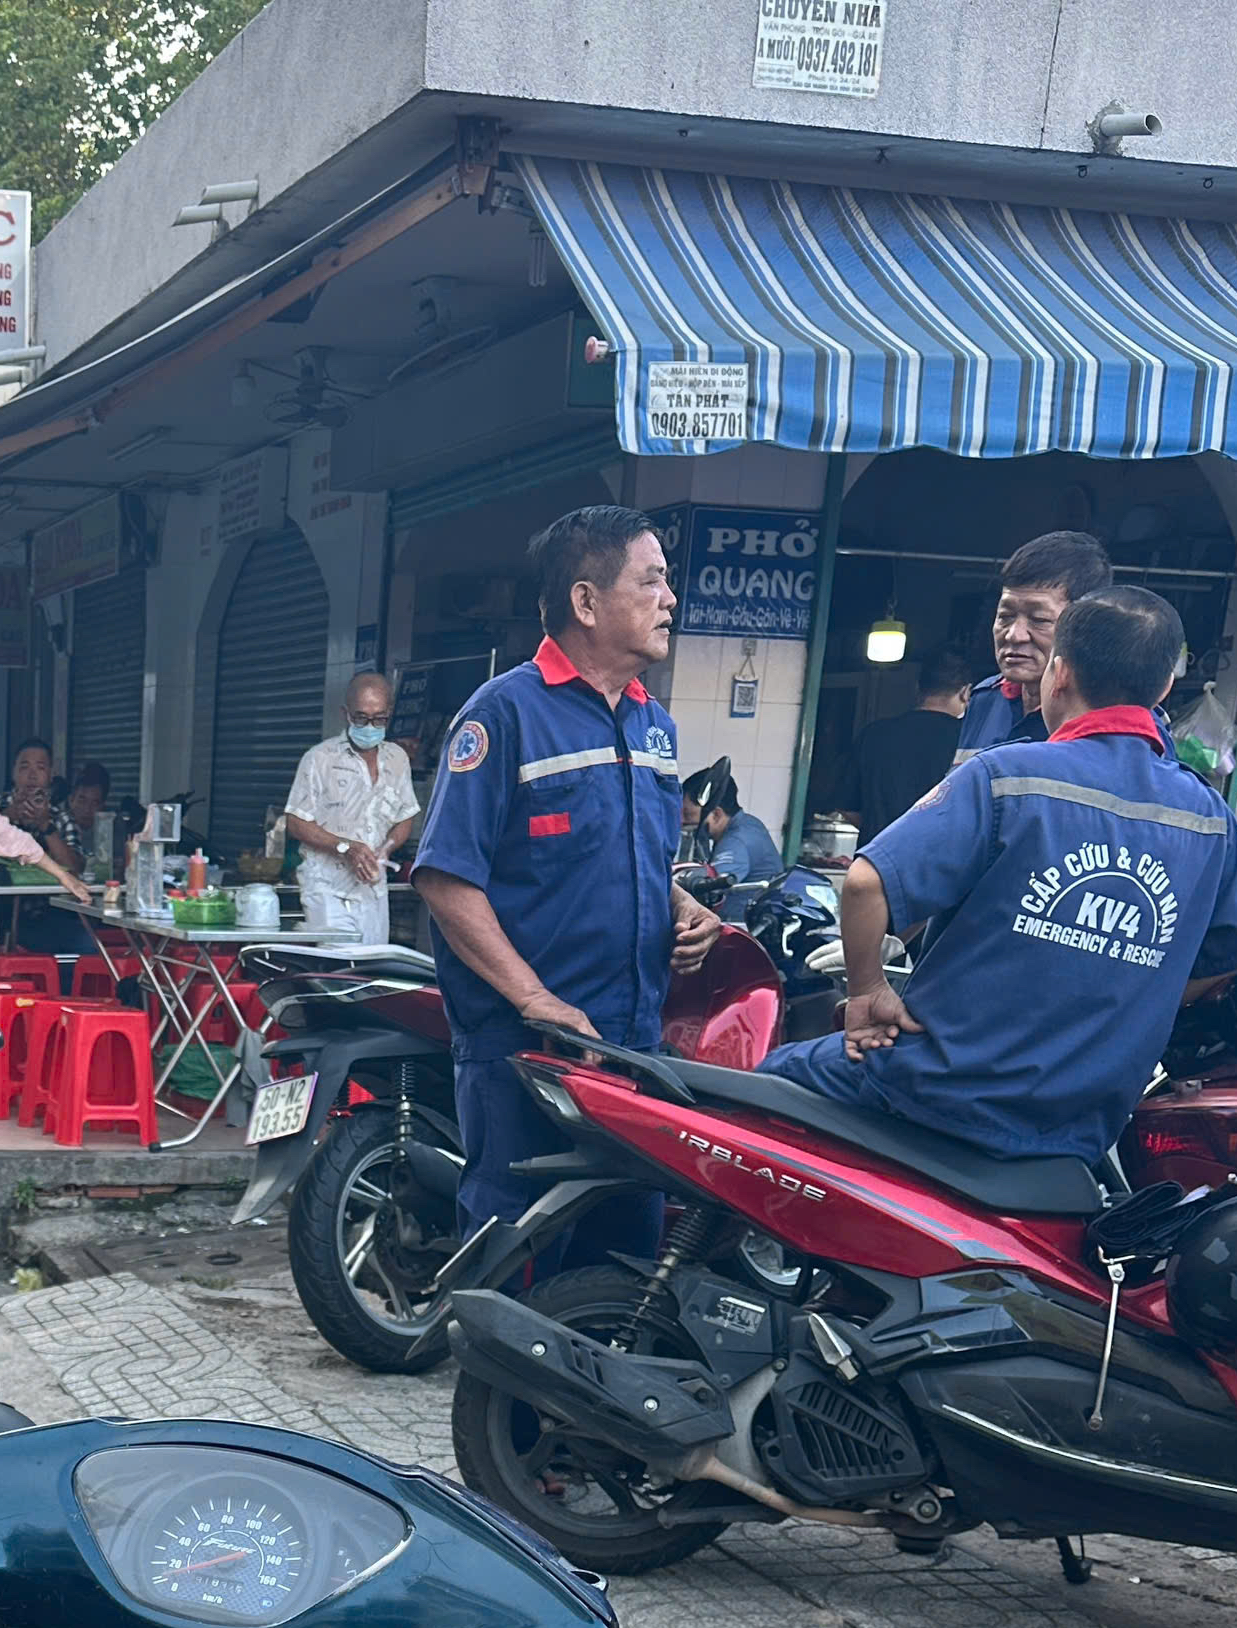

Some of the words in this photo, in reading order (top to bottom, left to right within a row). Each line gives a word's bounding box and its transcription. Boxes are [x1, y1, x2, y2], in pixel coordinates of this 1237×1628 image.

[797, 37, 878, 77] 0937.492.181
[651, 412, 743, 438] 0903.857701
[707, 518, 820, 559] PHỞ
[698, 565, 815, 601] QUANG
[1020, 866, 1062, 914] CẤP
[1063, 841, 1110, 877] CỨU
[1116, 846, 1132, 871] &
[1136, 853, 1171, 896] CỨU
[1158, 892, 1178, 945] NẠN
[1074, 891, 1142, 939] KV4
[1013, 912, 1109, 955] EMERGENCY
[1109, 940, 1122, 959] &
[1122, 943, 1166, 969] RESC
[260, 1079, 306, 1113] 50-N2
[252, 1105, 304, 1140] 193.55
[197, 1522, 211, 1532] 60
[221, 1514, 234, 1525] 80
[245, 1519, 262, 1530] 100
[179, 1536, 192, 1547] 40
[259, 1535, 276, 1546] 120
[168, 1558, 182, 1569] 20
[265, 1554, 282, 1566] 140
[259, 1575, 277, 1586] 160
[202, 1592, 223, 1604] km/h
